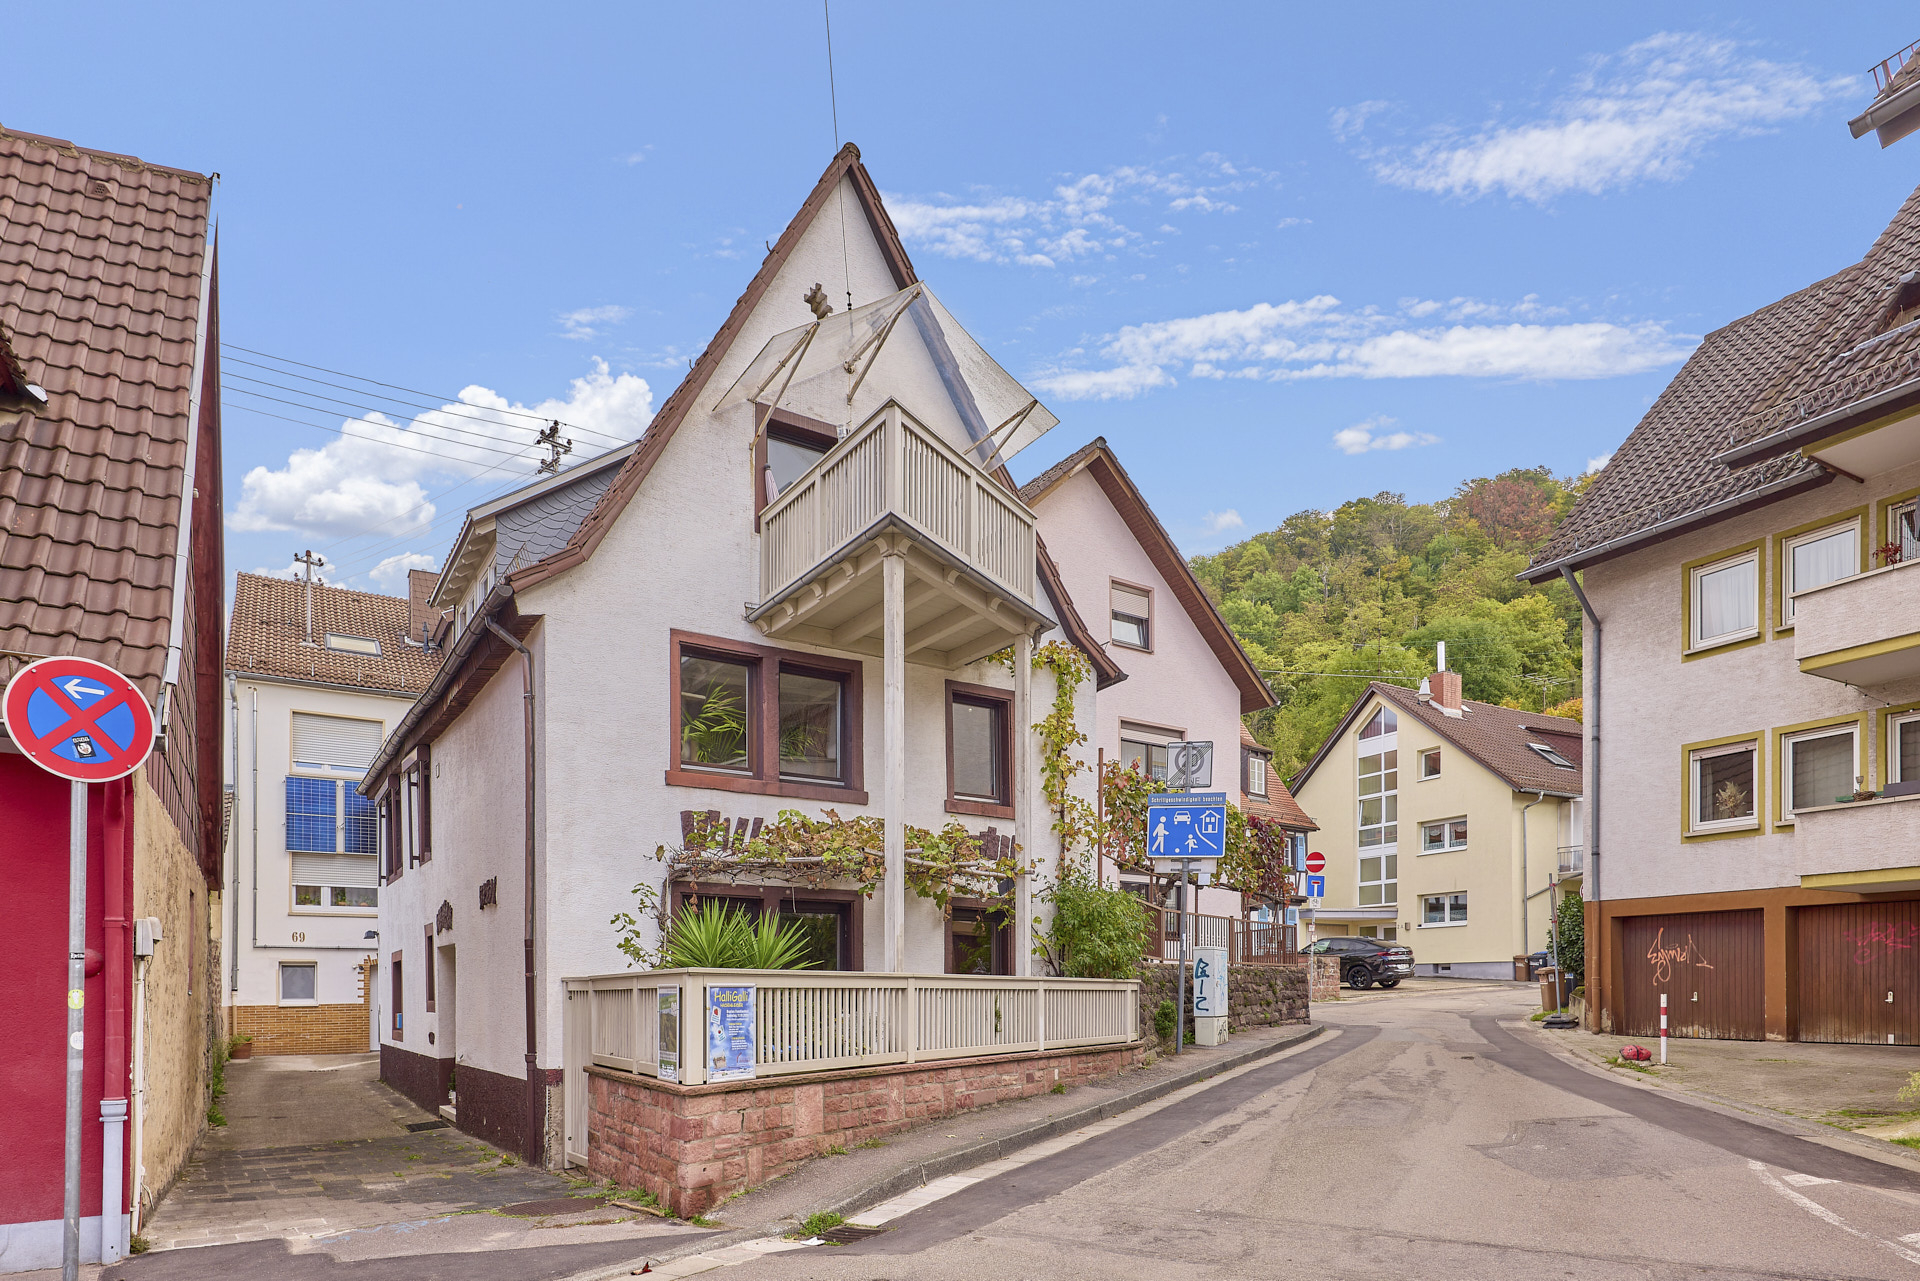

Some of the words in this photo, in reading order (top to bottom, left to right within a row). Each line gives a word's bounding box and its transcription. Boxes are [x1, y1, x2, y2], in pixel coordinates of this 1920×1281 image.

[1151, 796, 1201, 804] Schrittgeschwindigkeit
[291, 931, 306, 943] 69
[714, 990, 749, 1003] HalliGalli
